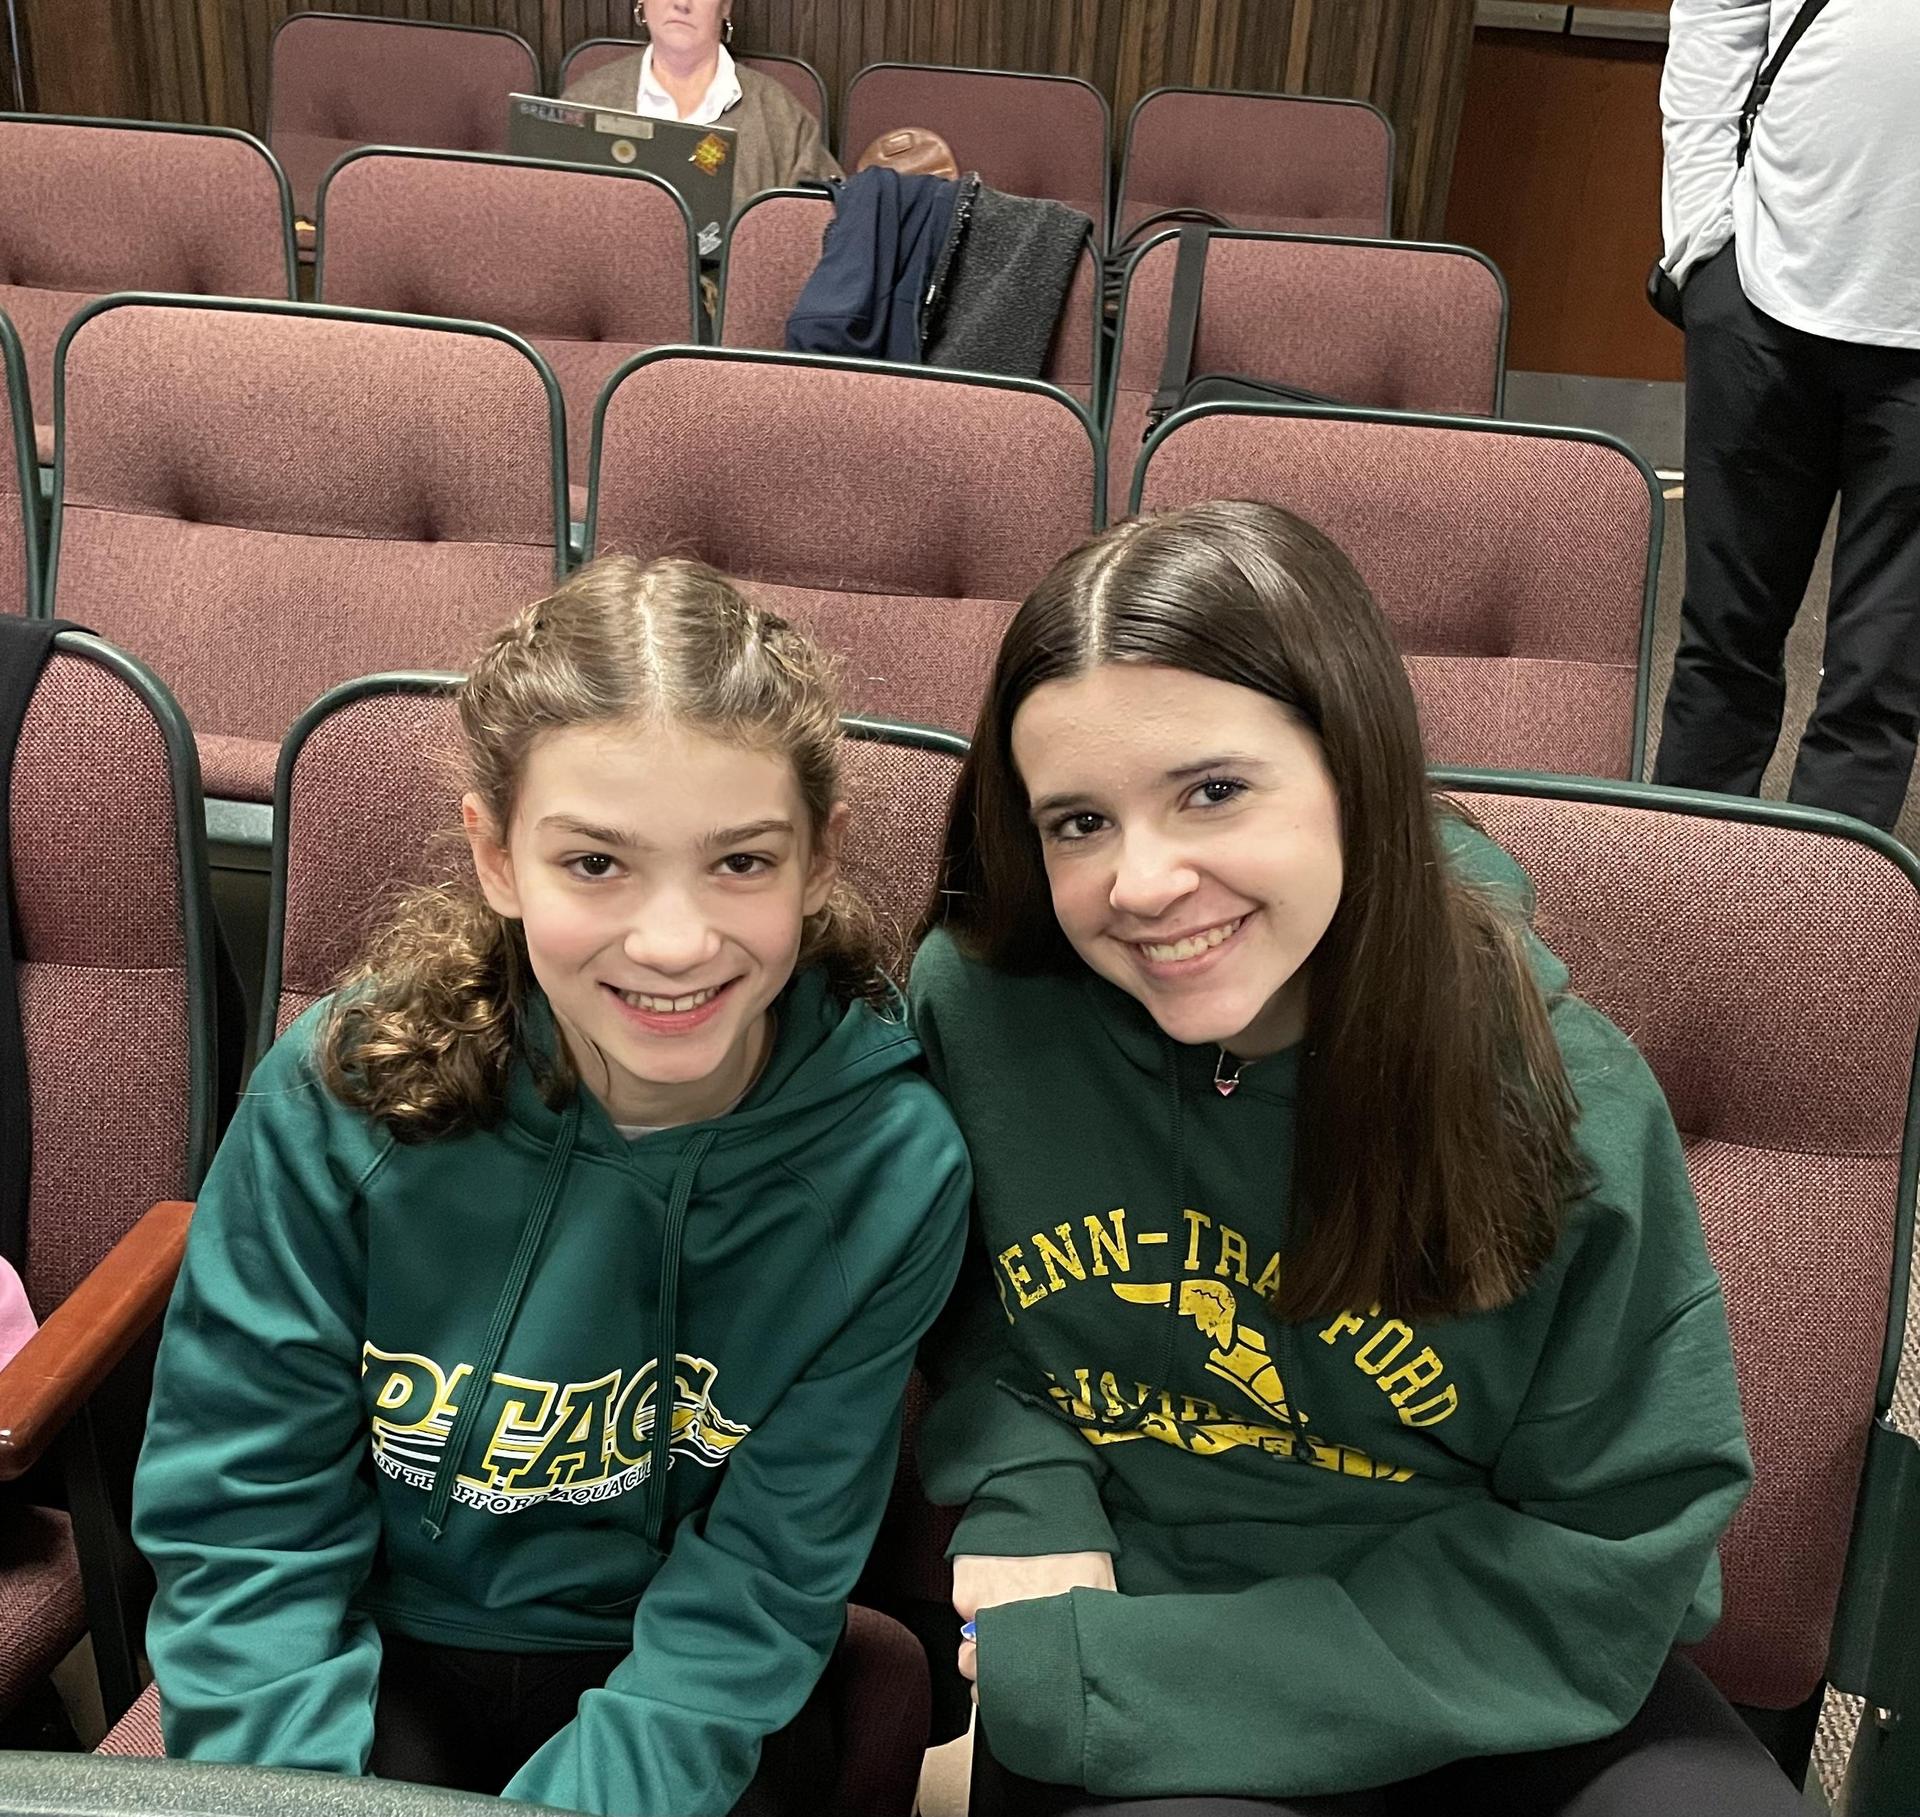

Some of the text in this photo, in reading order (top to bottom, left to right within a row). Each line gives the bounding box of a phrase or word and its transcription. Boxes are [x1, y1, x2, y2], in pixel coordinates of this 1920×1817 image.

[993, 1208, 1459, 1427] ENN-TRAFORD
[361, 1339, 719, 1494] PTAC
[548, 1480, 622, 1505] AQUA
[624, 1455, 676, 1491] CL
